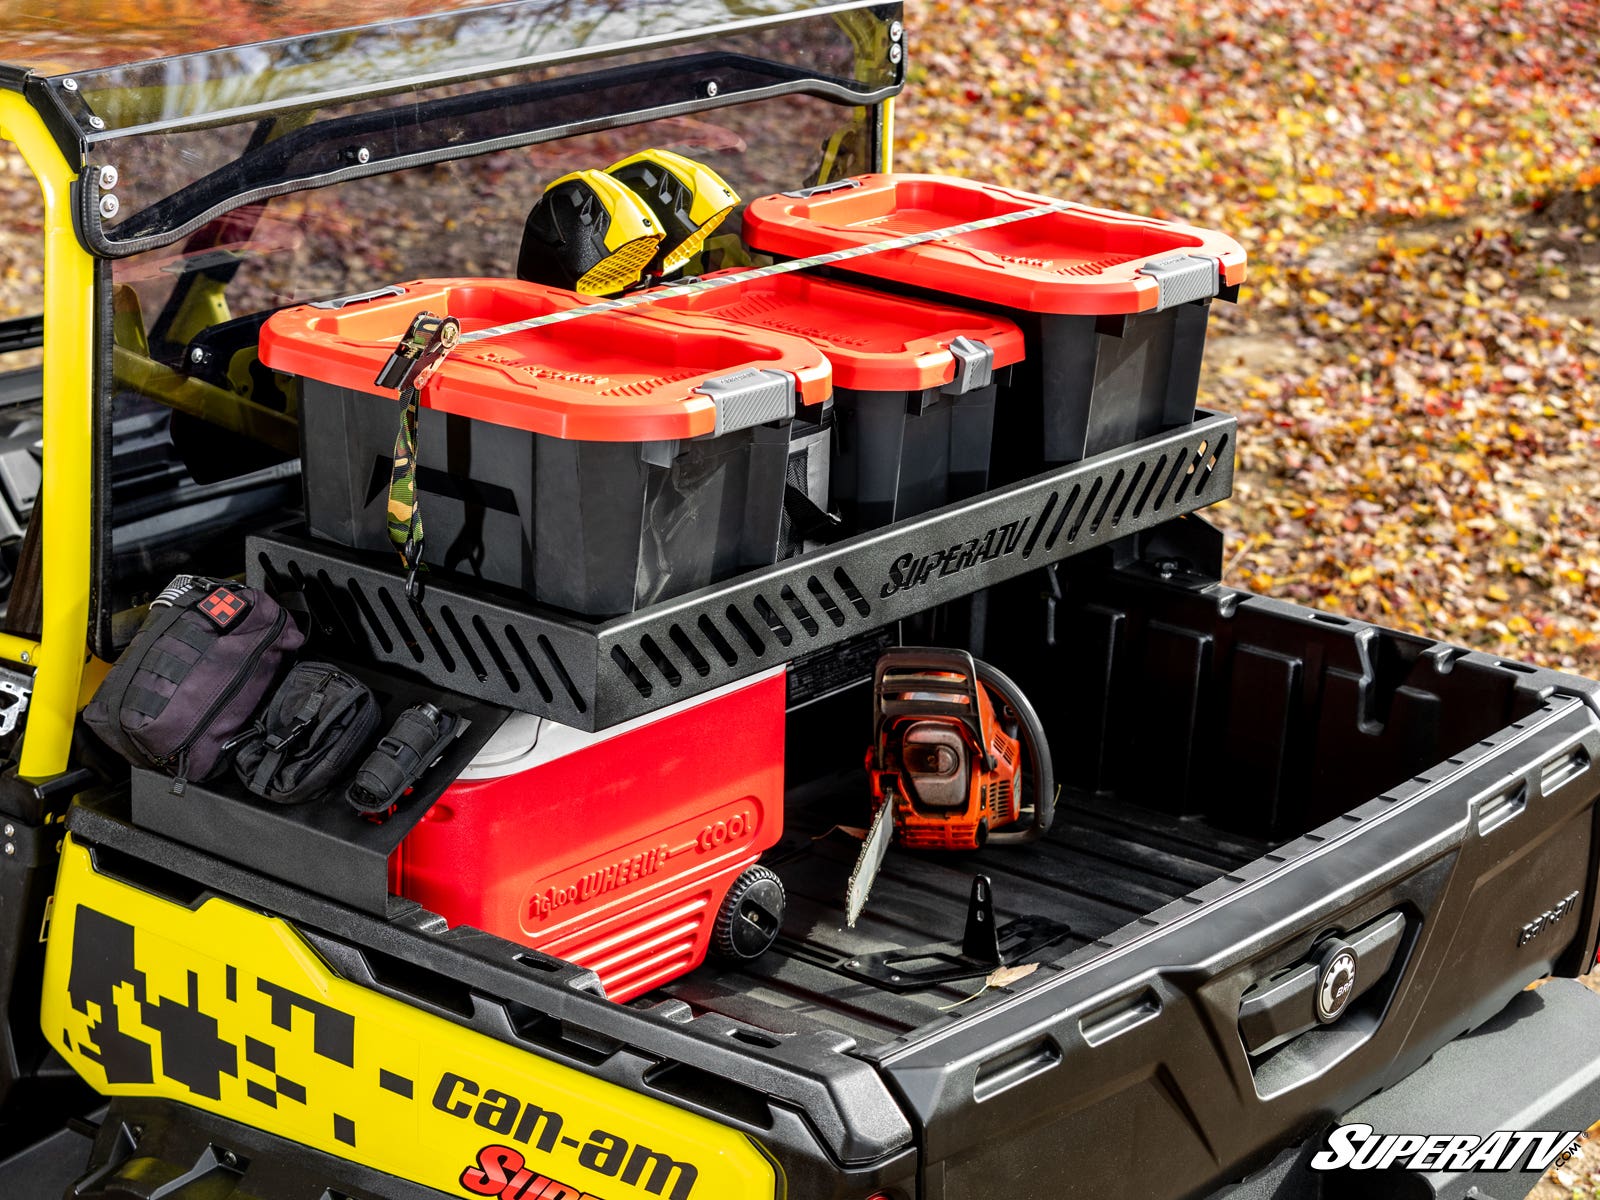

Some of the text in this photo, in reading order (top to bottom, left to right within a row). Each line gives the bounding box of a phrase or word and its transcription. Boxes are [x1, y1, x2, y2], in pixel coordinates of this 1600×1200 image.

[880, 516, 1031, 598] SUPERATV
[530, 884, 578, 919] igloo
[432, 1072, 699, 1200] can-am
